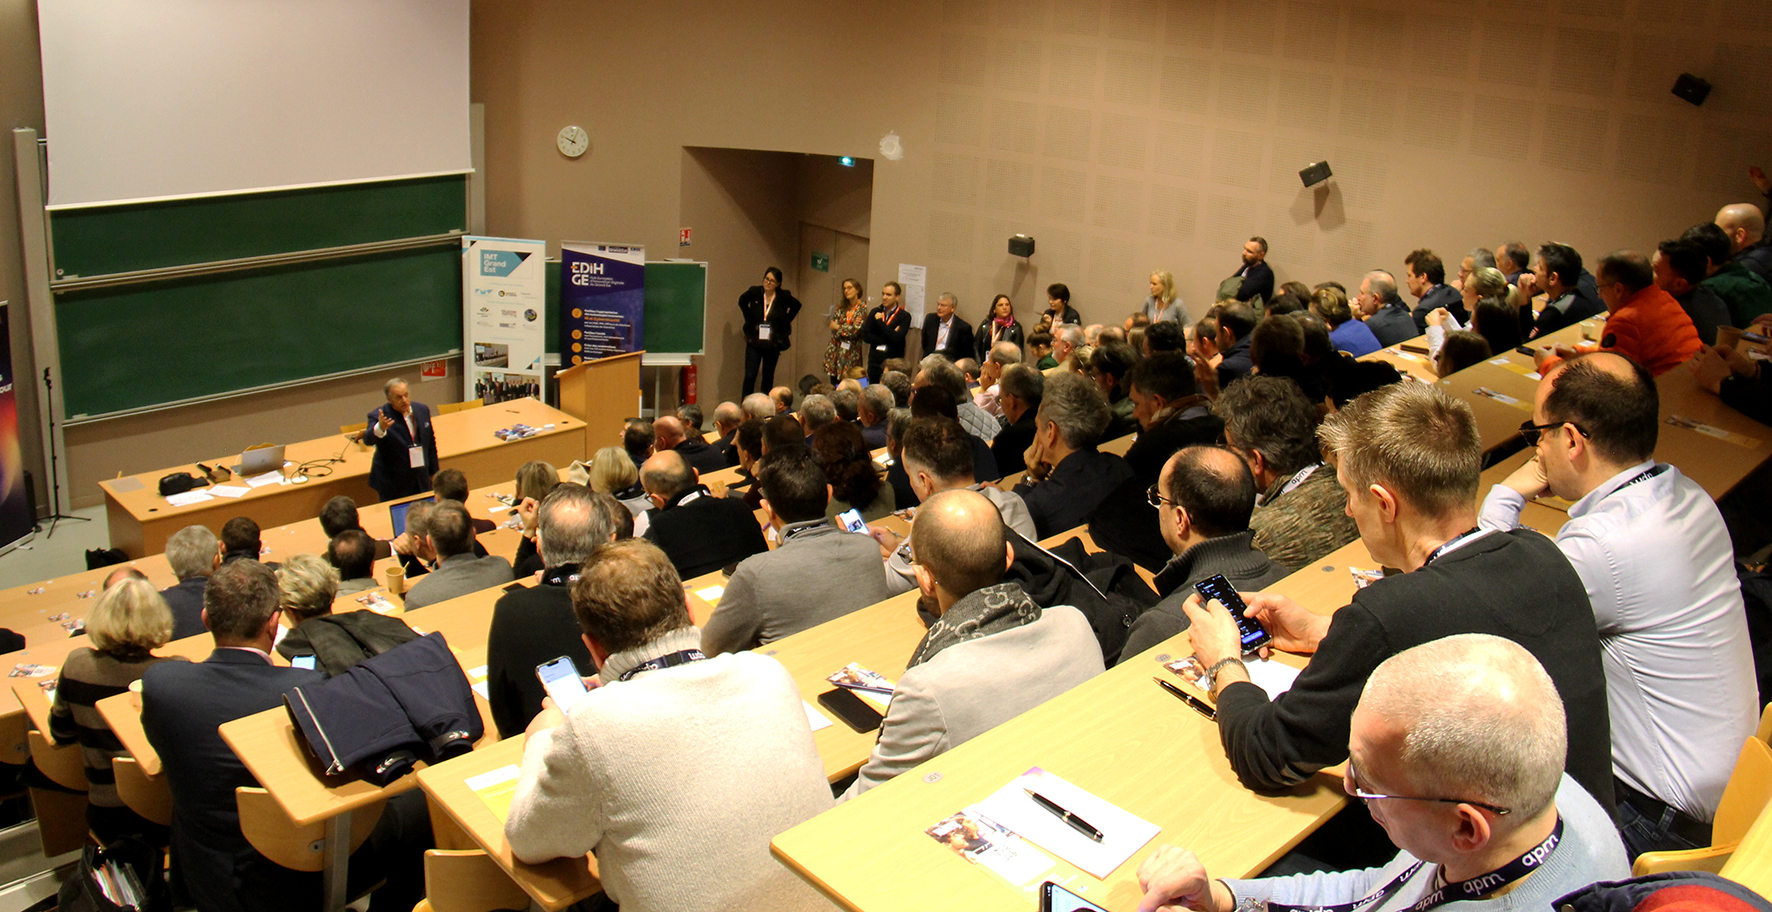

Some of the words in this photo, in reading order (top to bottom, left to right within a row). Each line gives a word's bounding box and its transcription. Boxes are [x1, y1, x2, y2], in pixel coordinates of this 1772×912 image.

[483, 259, 507, 267] Grand
[571, 274, 589, 286] GE
[1291, 470, 1308, 485] apm
[1521, 833, 1559, 865] apm
[1463, 873, 1506, 896] apm
[1415, 889, 1445, 912] apm
